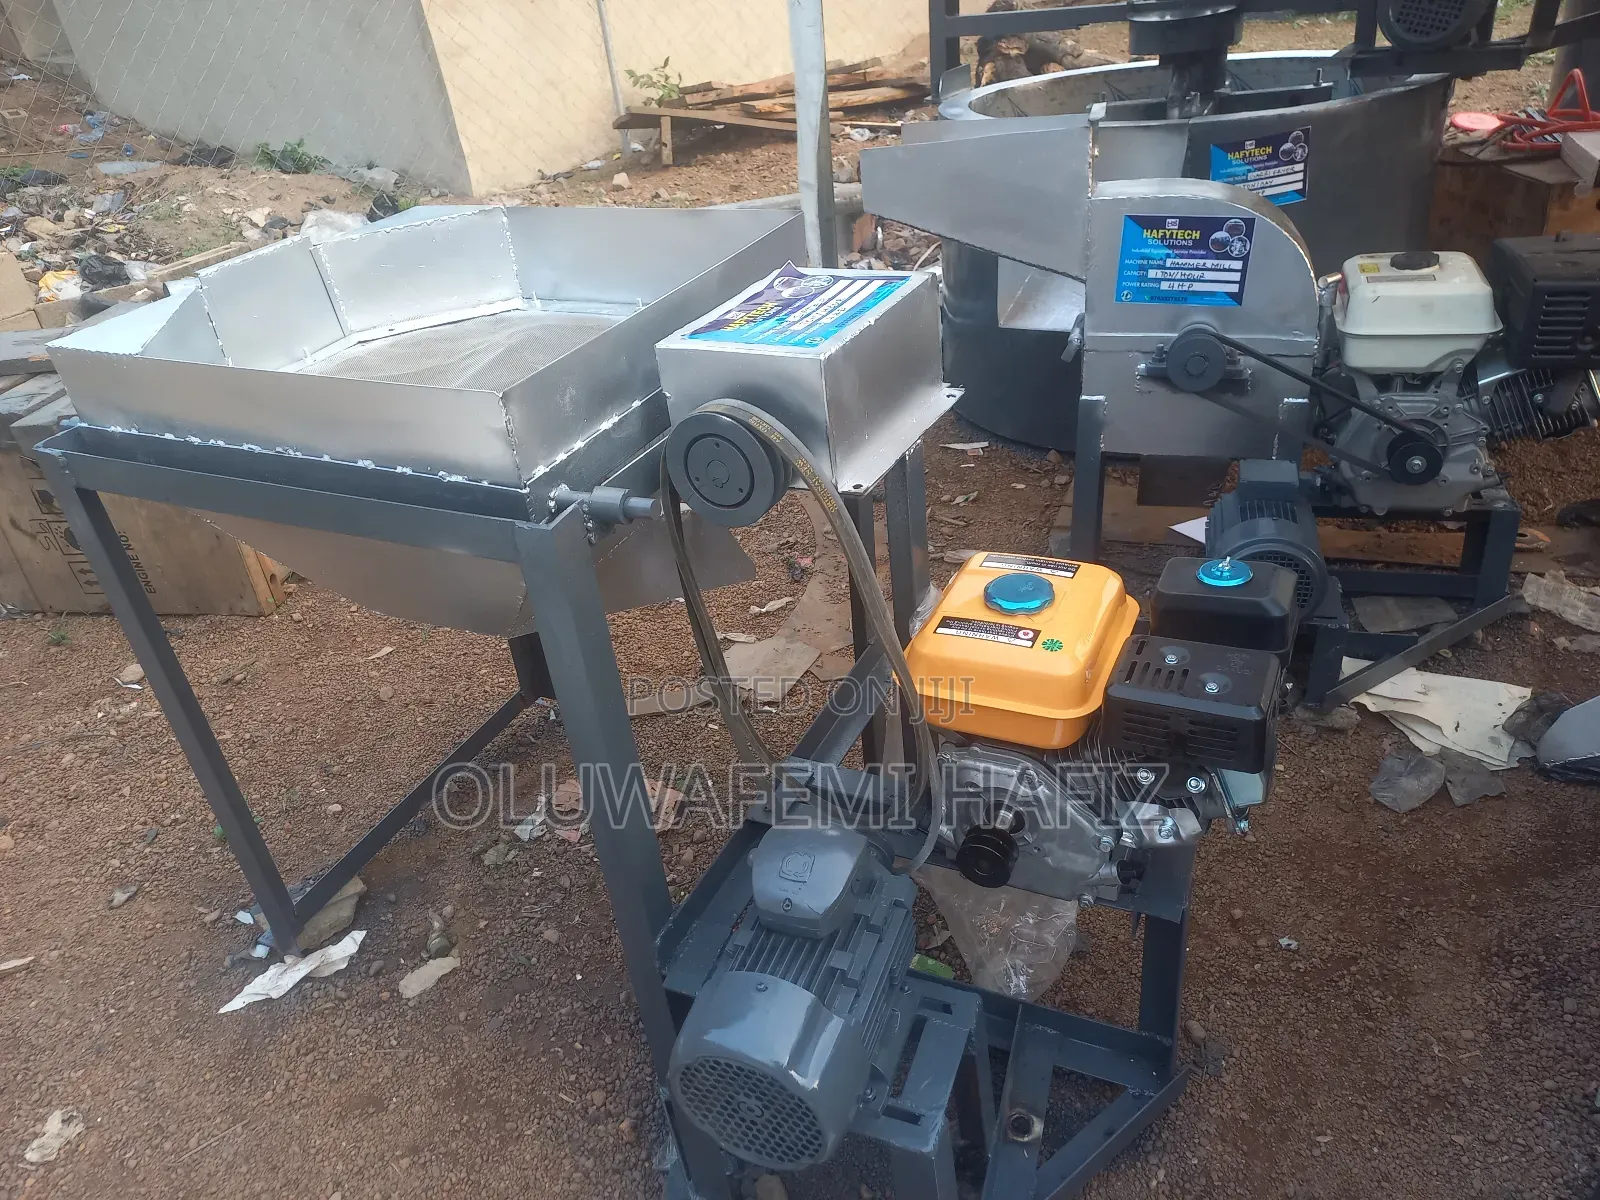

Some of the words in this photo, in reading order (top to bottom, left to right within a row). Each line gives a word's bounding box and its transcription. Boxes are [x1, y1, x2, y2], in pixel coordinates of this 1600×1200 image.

[1227, 146, 1272, 160] HAFYTECH
[1232, 154, 1267, 165] SOLUTIONS
[1143, 229, 1201, 240] HAFYTECH
[1169, 260, 1208, 268] HAMMER
[128, 554, 156, 594] ENGINE
